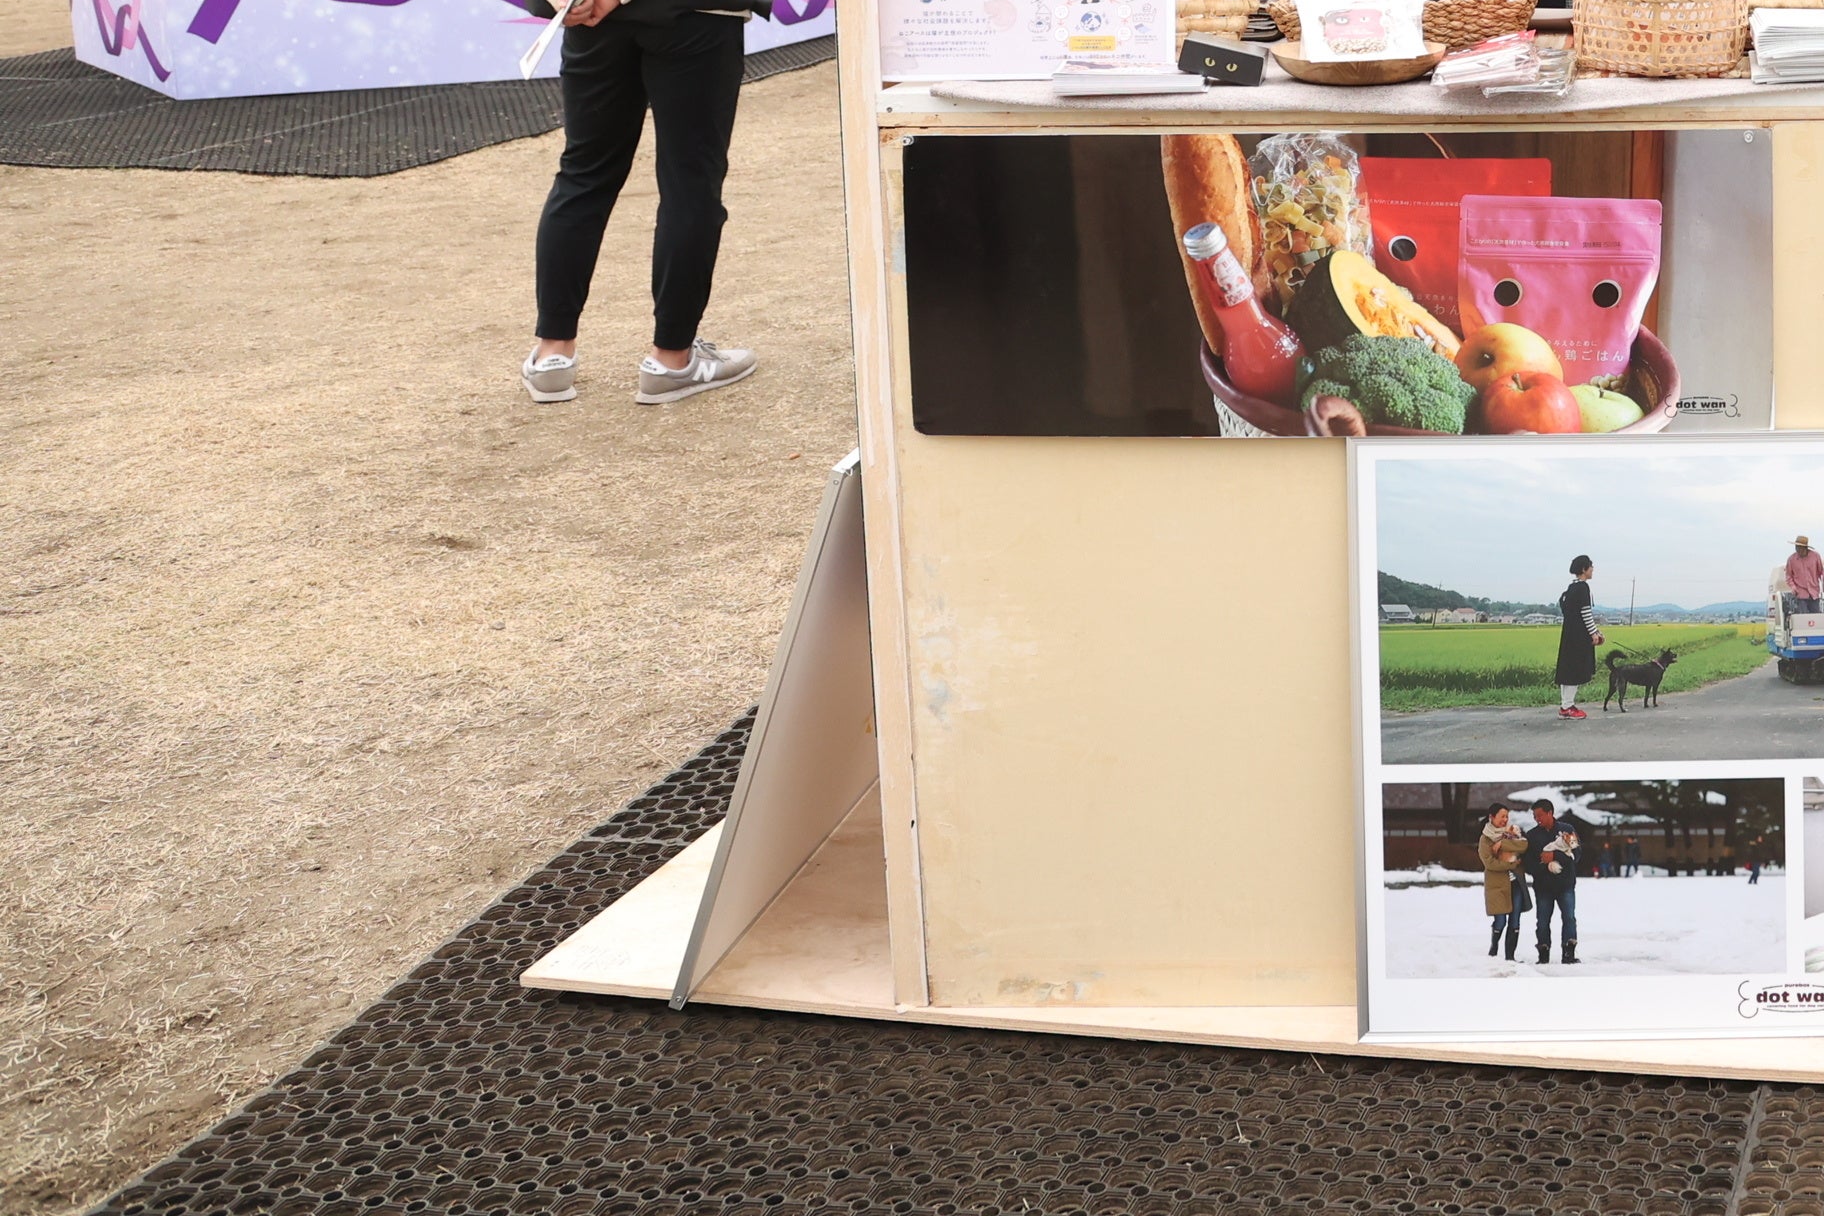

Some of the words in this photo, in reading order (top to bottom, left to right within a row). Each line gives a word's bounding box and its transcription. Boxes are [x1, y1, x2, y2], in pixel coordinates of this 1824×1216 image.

[1676, 401, 1697, 409] dot
[1701, 401, 1726, 409] wan
[1756, 991, 1790, 1003] dot
